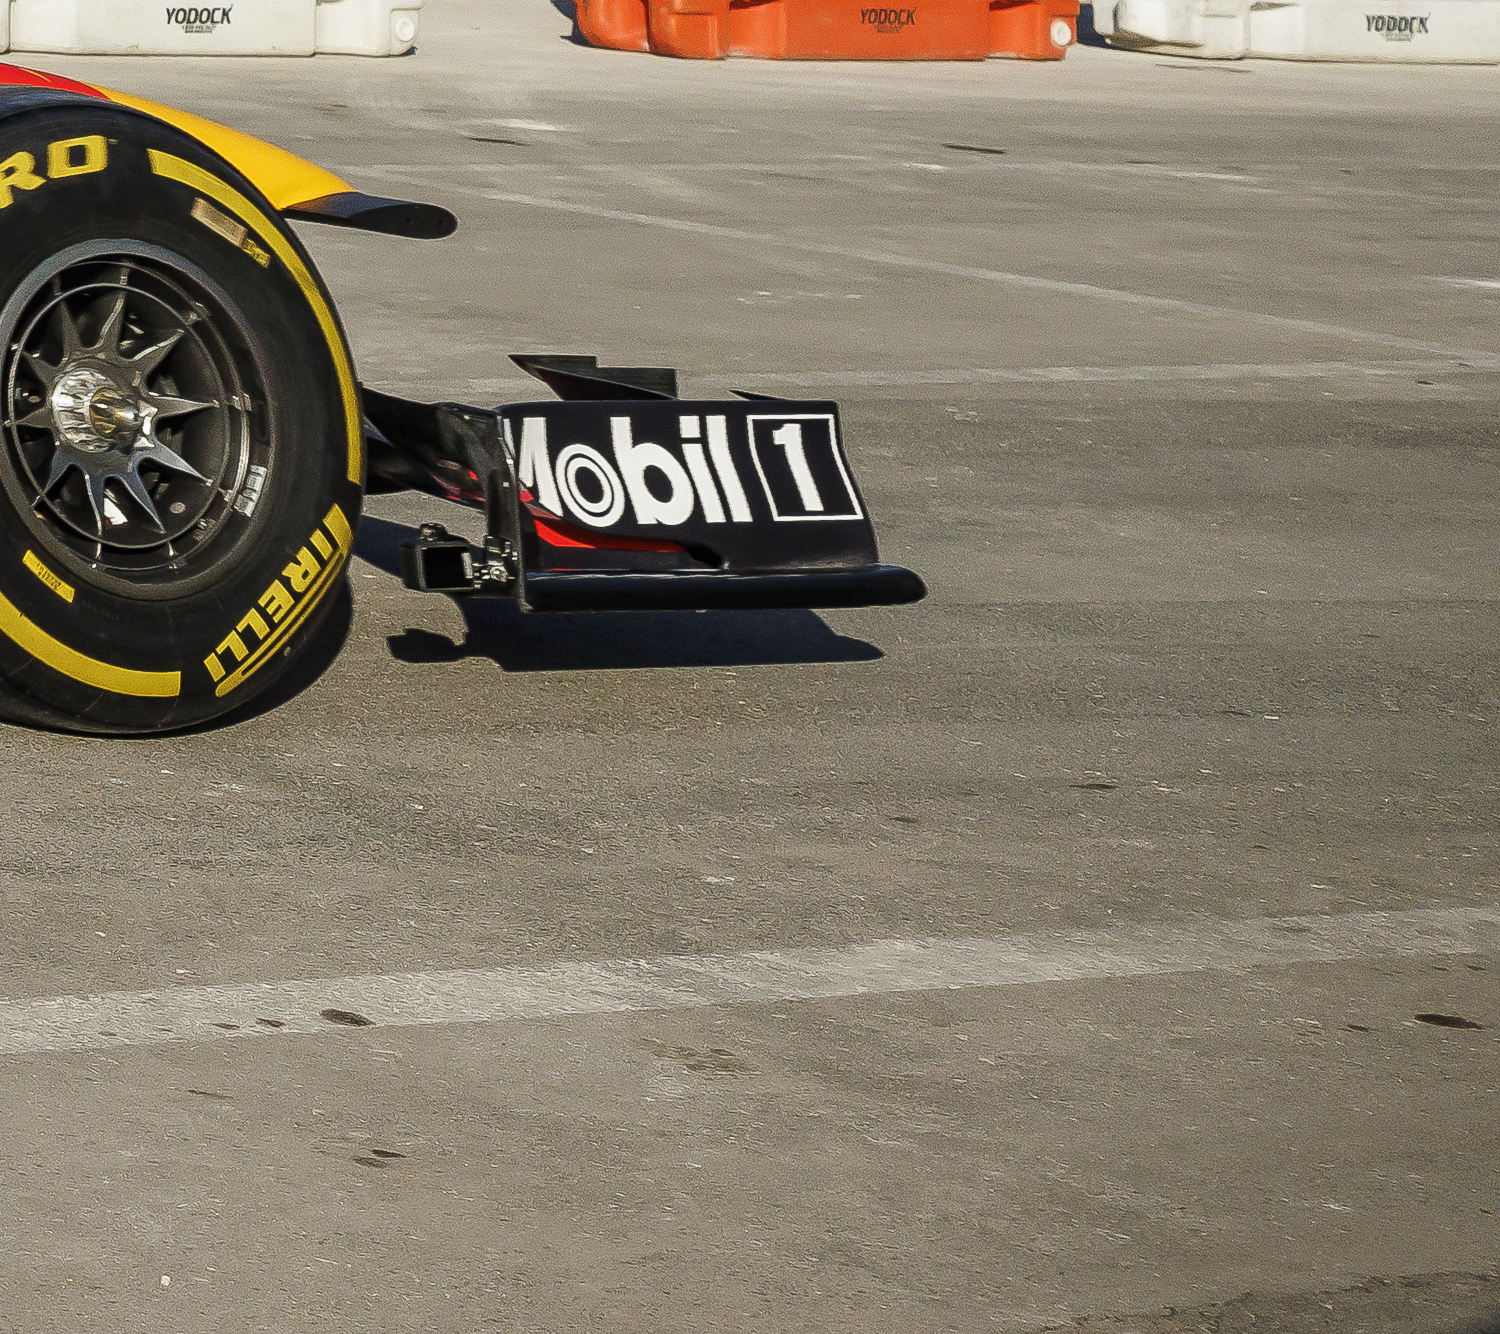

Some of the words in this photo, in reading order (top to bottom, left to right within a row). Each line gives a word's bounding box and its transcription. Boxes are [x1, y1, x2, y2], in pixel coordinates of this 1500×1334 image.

[166, 3, 233, 25] YODOCK
[861, 7, 917, 26] YODOCK
[1365, 12, 1430, 34] YODOCK
[504, 414, 754, 527] Mobil
[773, 422, 825, 513] 1
[203, 502, 354, 698] PIRELLI
